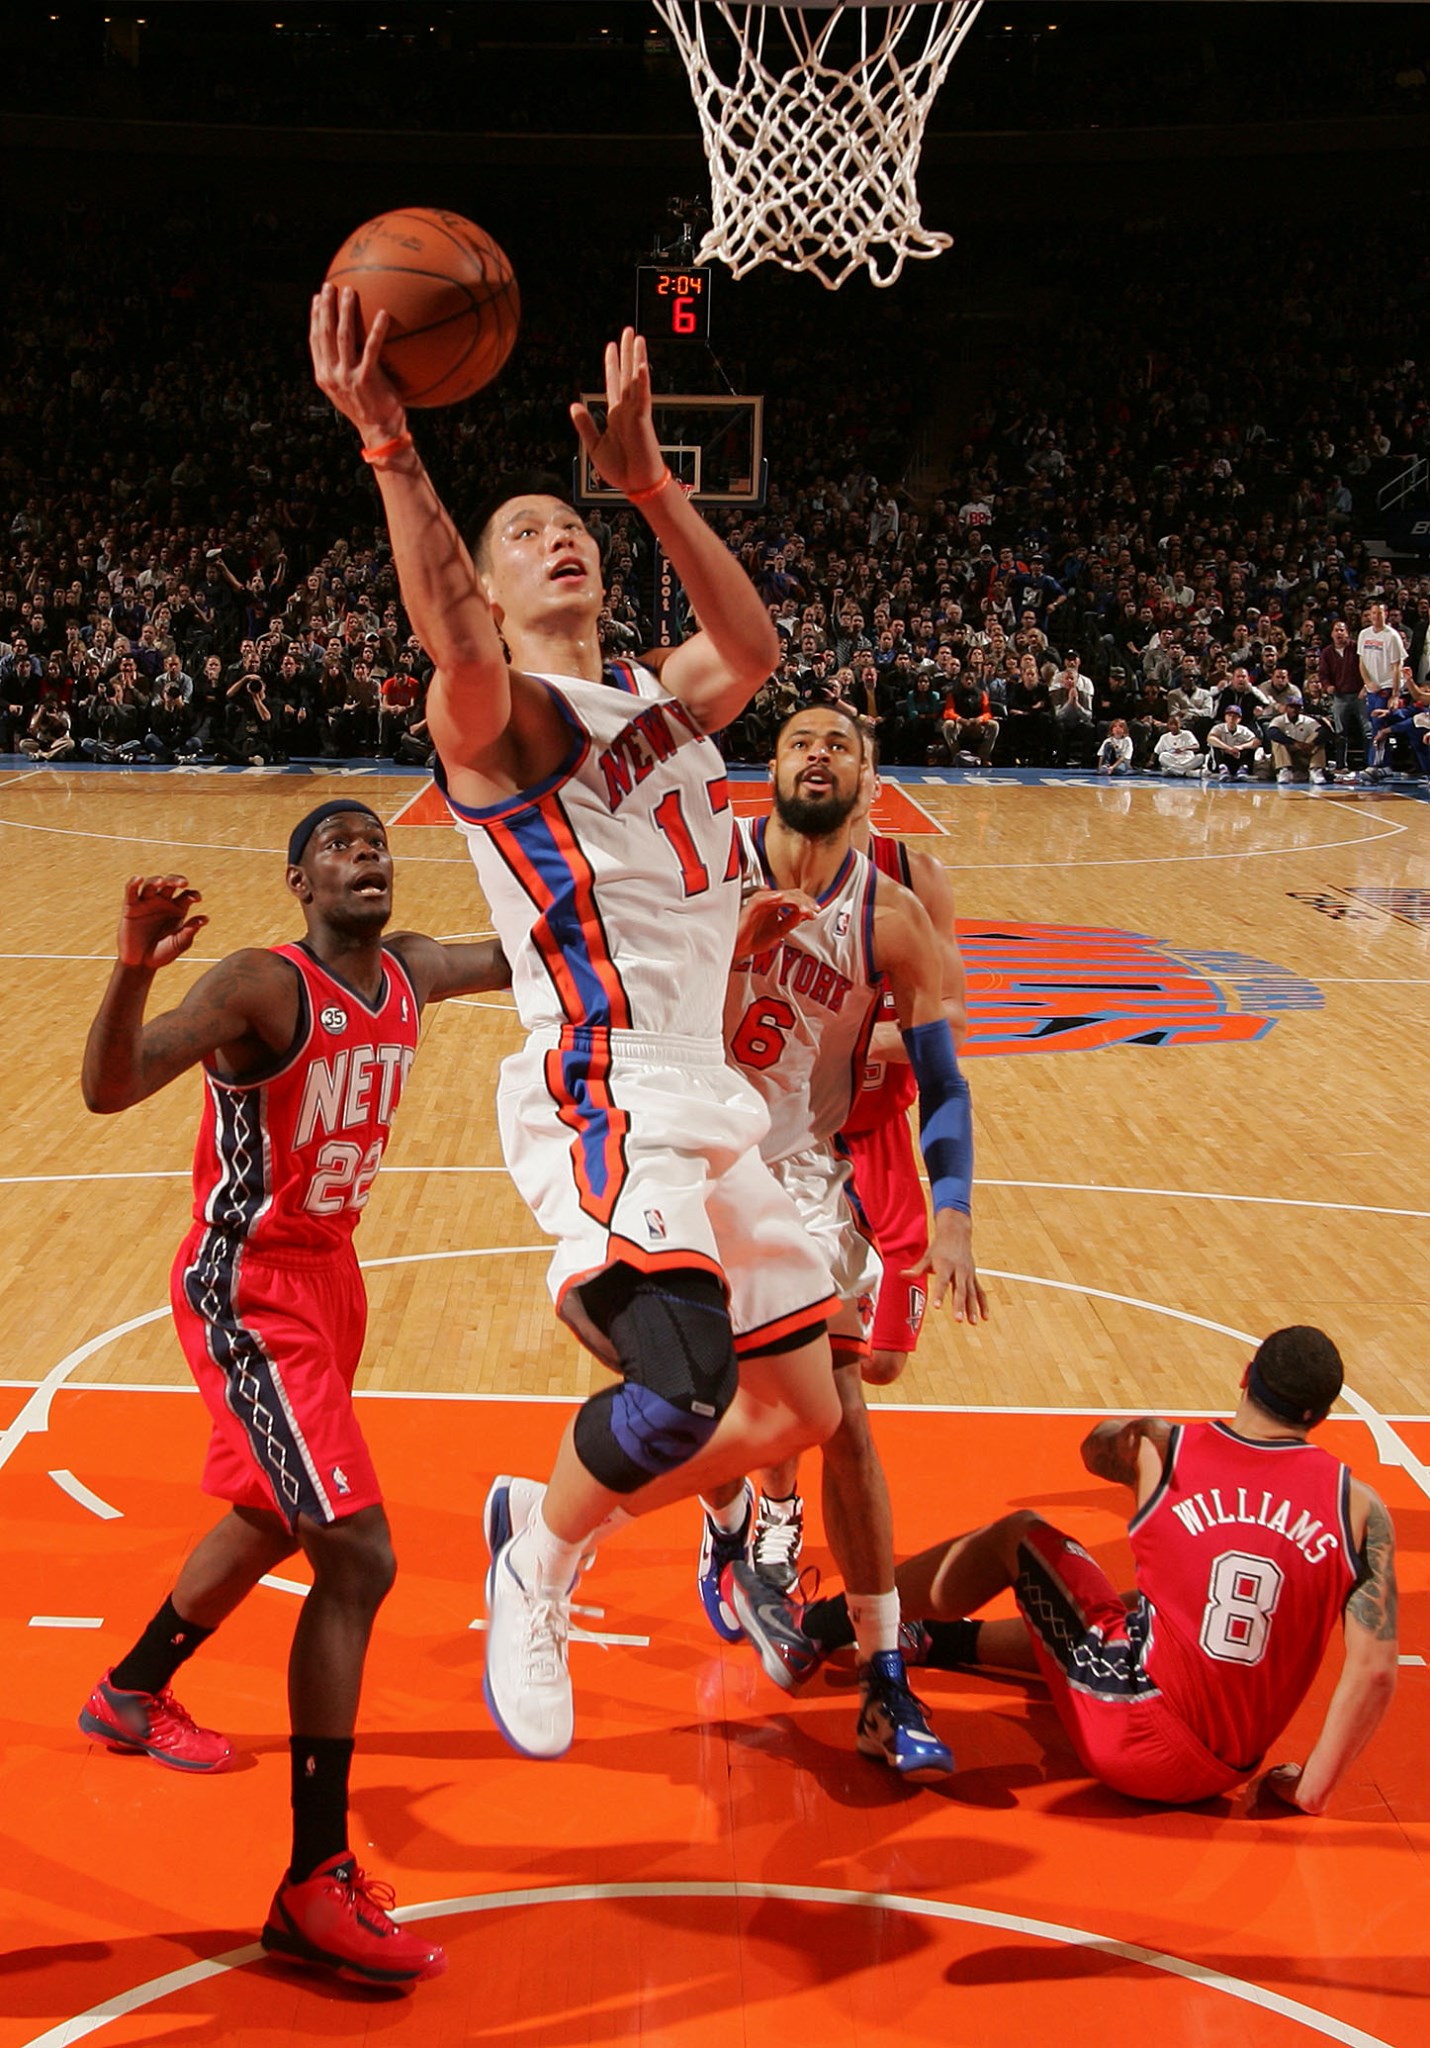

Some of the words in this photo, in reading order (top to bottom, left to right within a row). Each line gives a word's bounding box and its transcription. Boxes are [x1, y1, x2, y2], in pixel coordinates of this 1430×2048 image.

[657, 275, 702, 295] 2:04
[672, 297, 696, 334] 6
[598, 702, 678, 814] NEW
[778, 943, 854, 1015] YORK
[324, 1010, 344, 1027] 35
[730, 995, 797, 1071] 6
[303, 1136, 384, 1216] 22
[1171, 1487, 1339, 1565] WILLIAMS
[1199, 1549, 1285, 1667] 8
